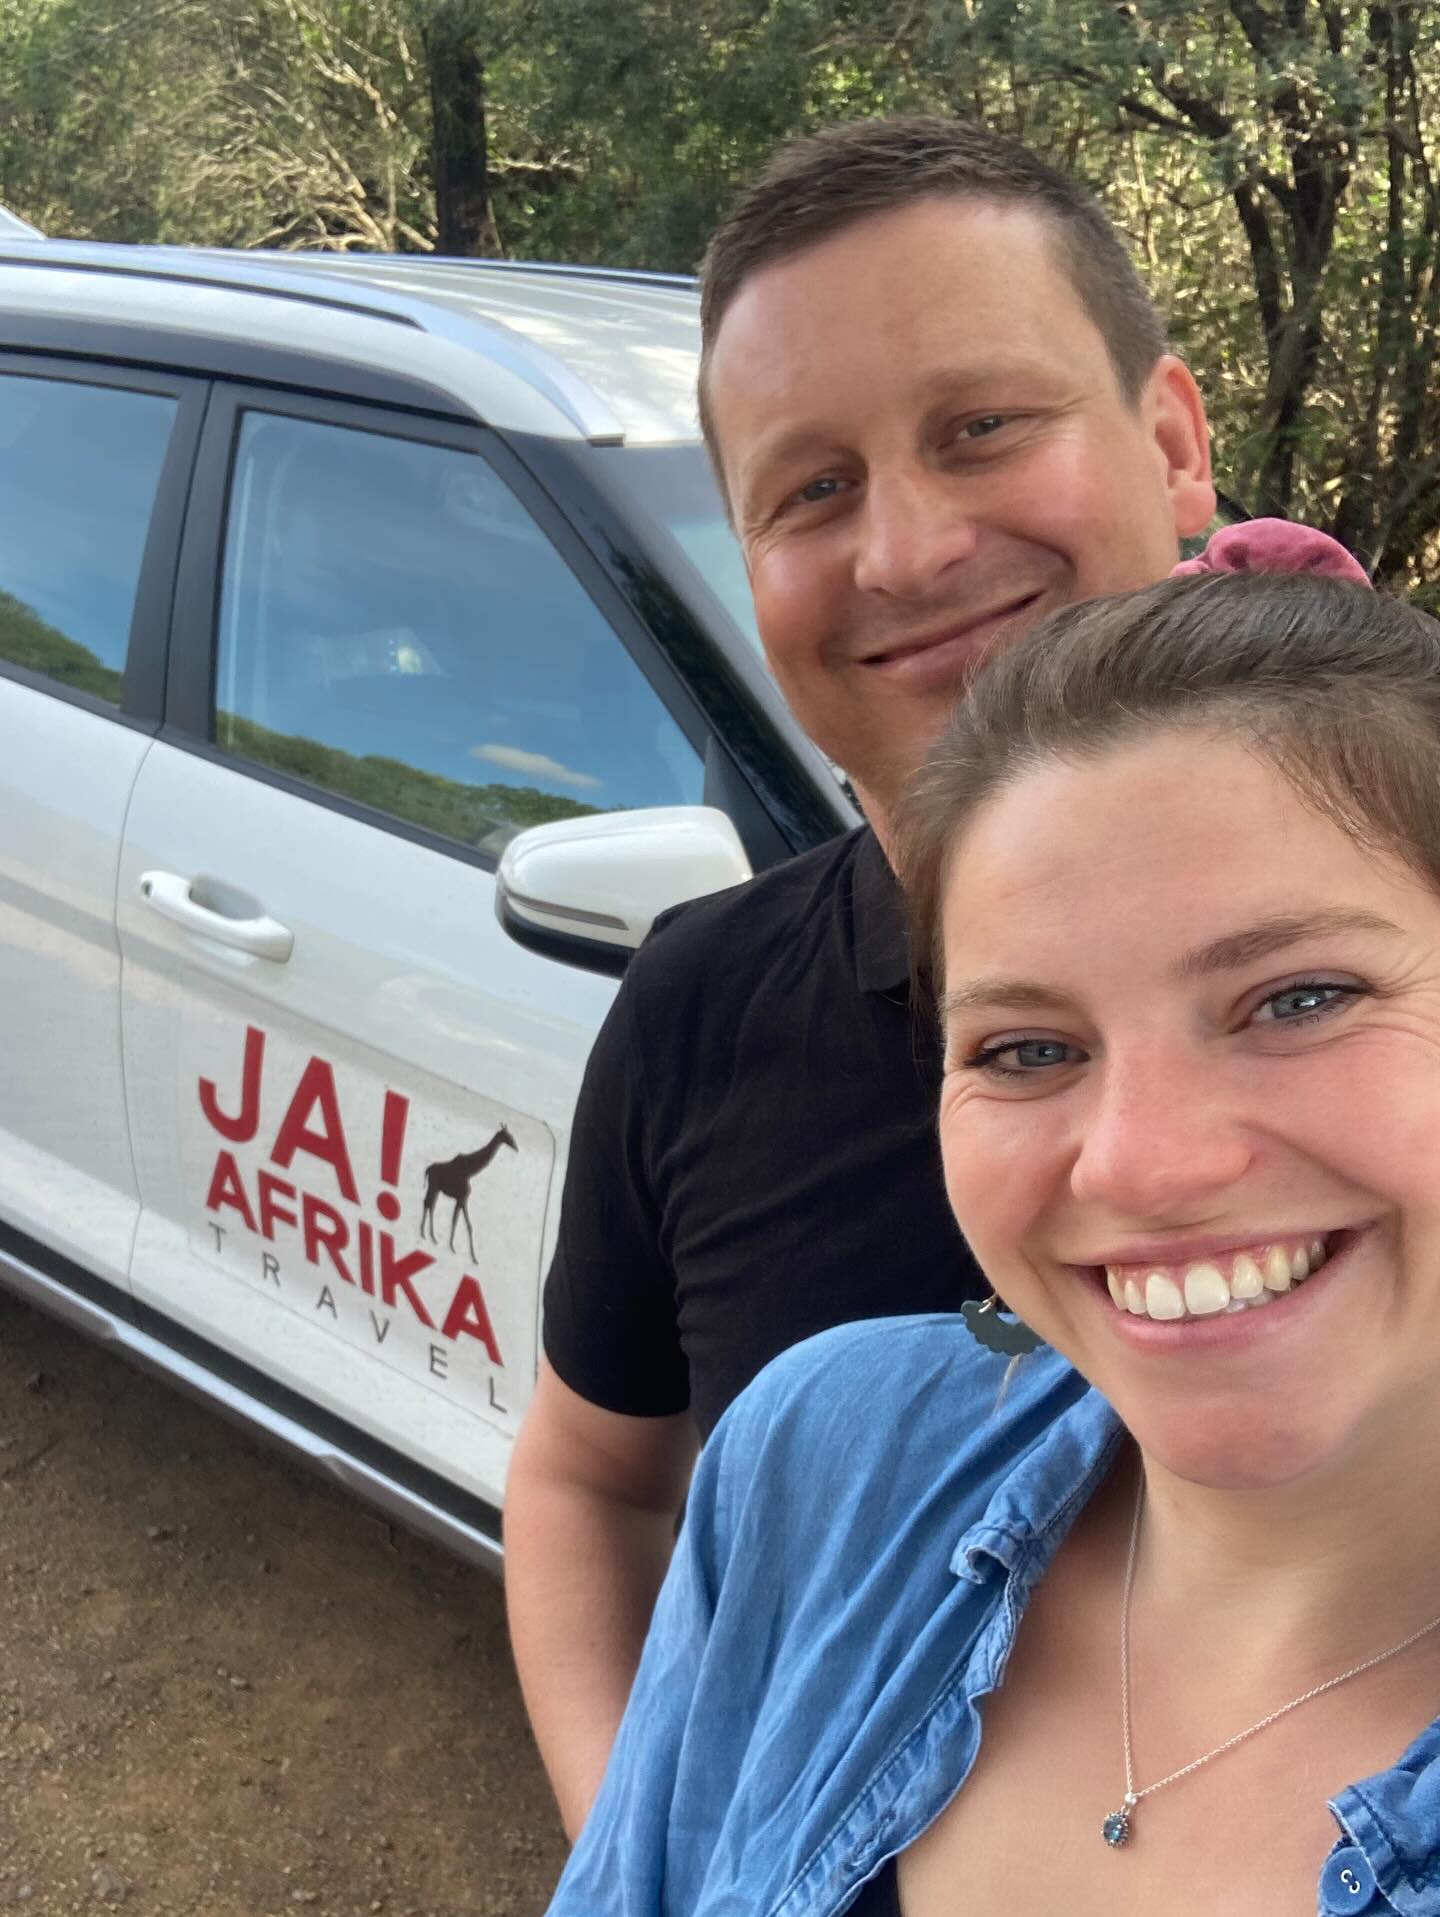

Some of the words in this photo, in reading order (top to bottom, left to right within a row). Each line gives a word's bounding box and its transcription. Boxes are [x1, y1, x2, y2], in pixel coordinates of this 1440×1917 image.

[199, 1024, 410, 1222] JA!
[206, 1149, 504, 1368] AFRIKA
[208, 1221, 508, 1414] TRAVEL
